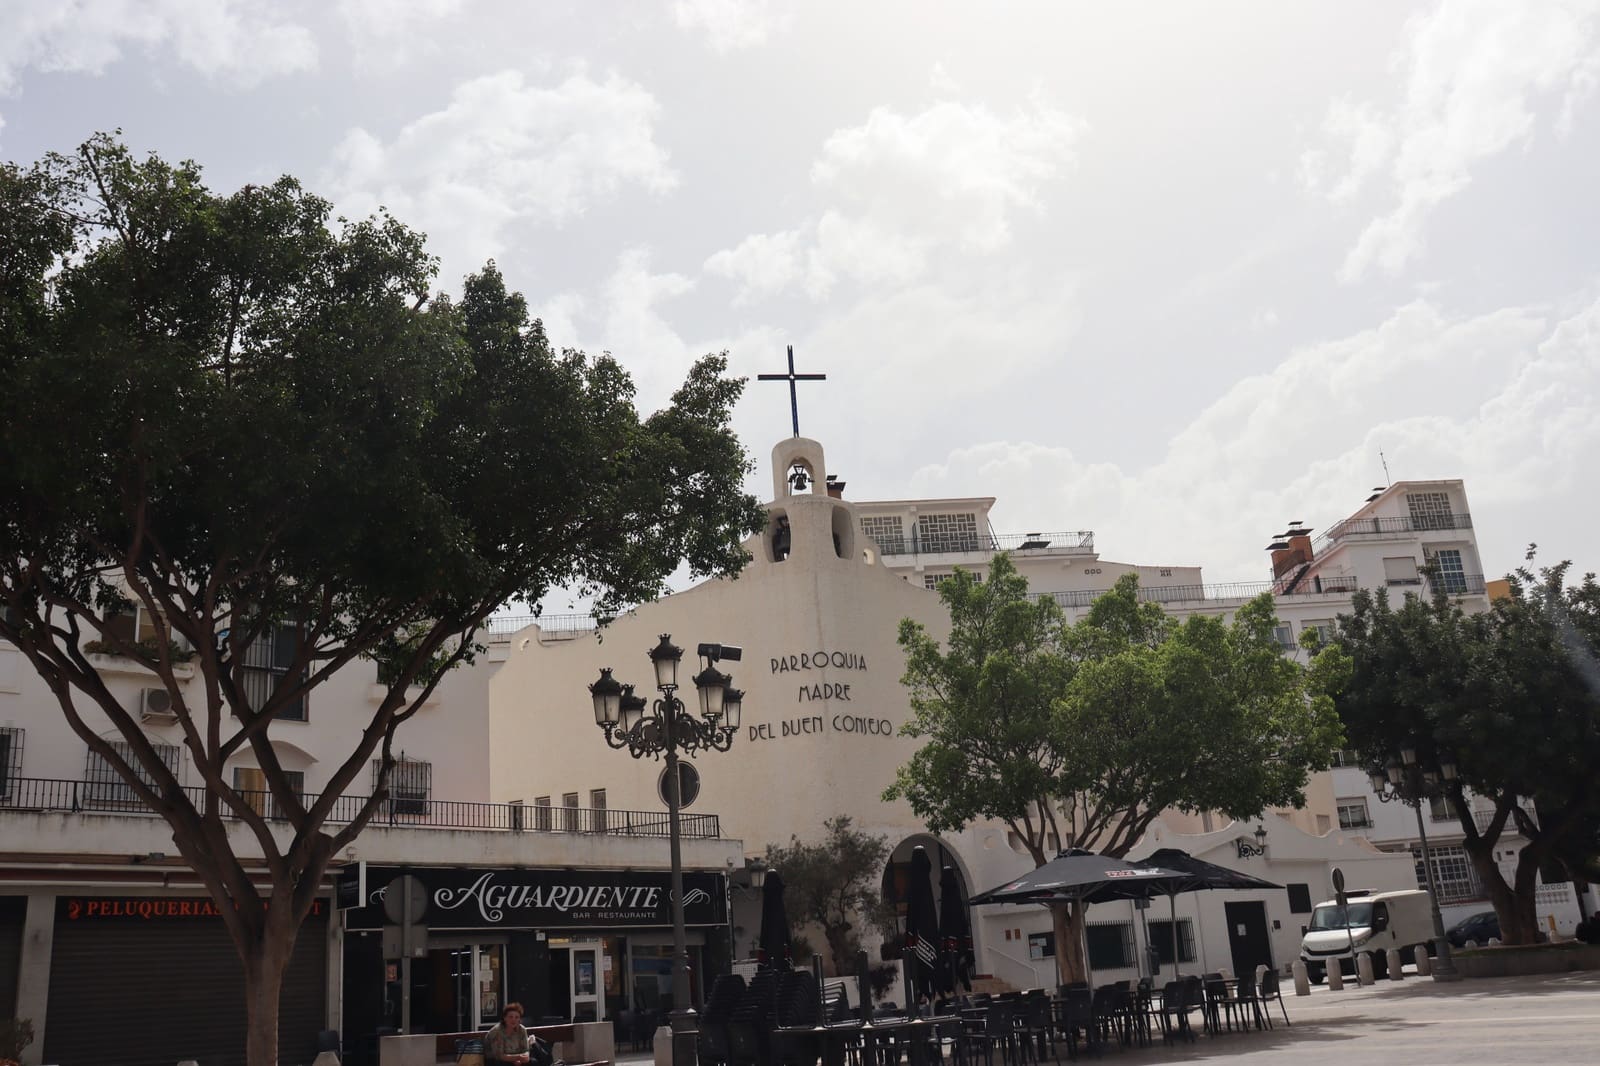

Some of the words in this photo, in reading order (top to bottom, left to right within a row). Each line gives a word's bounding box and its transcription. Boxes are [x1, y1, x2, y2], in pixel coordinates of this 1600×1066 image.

[771, 651, 867, 674] PARROQUIA
[798, 683, 851, 702] MADRE
[749, 724, 776, 742] DEL
[781, 716, 823, 737] BUEN
[832, 715, 892, 735] CONSEJO
